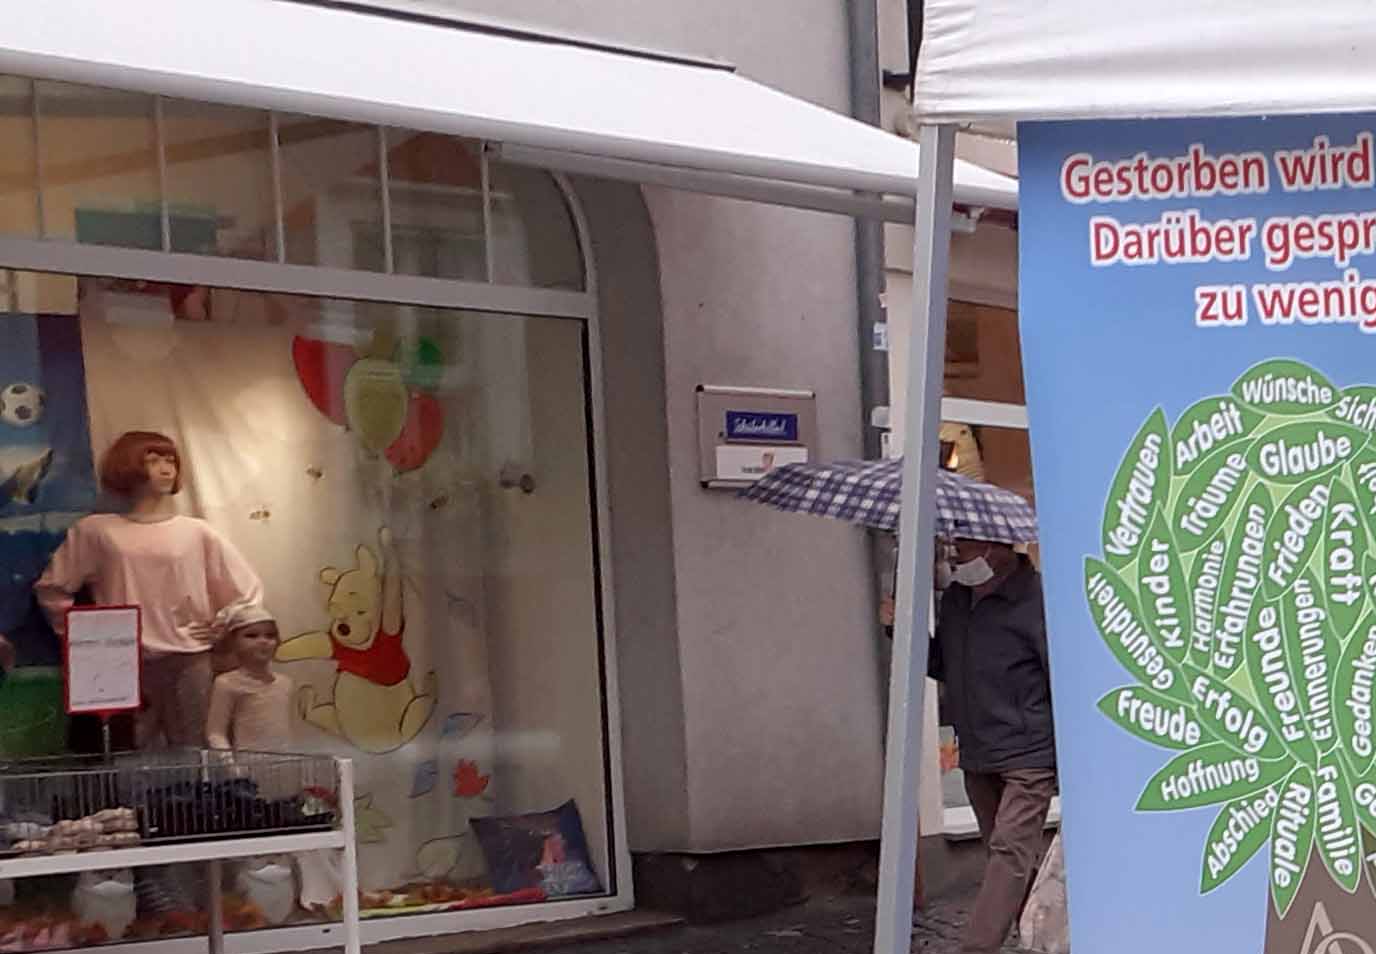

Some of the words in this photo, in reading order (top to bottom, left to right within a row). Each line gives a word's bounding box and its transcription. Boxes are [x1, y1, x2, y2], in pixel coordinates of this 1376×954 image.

[1064, 147, 1265, 198] Gestorben
[1280, 140, 1370, 187] wird
[1093, 219, 1252, 262] Darüber
[1200, 290, 1243, 320] zu
[1176, 401, 1244, 468] Arbeit
[1242, 374, 1332, 404] Wünsche
[1105, 433, 1161, 556] Vertrauen
[1181, 453, 1247, 535] Träume
[1260, 430, 1352, 476] Glaube
[1268, 482, 1329, 588] Frieden
[1329, 503, 1361, 605] Kraft
[1087, 572, 1174, 690] Gesundheit
[1142, 538, 1184, 648] Kinder
[1191, 540, 1224, 652] Harmonie
[1213, 503, 1266, 669] Erfahrungen
[1252, 606, 1304, 741] Freunde
[1293, 577, 1333, 741] Erinnerungen
[1117, 690, 1200, 745] Freude
[1191, 676, 1268, 752] Erfolg
[1161, 758, 1259, 801] Hoffnung
[1318, 765, 1356, 875] Familie
[1207, 784, 1278, 879] Abschied
[1274, 782, 1311, 887] Rituale
